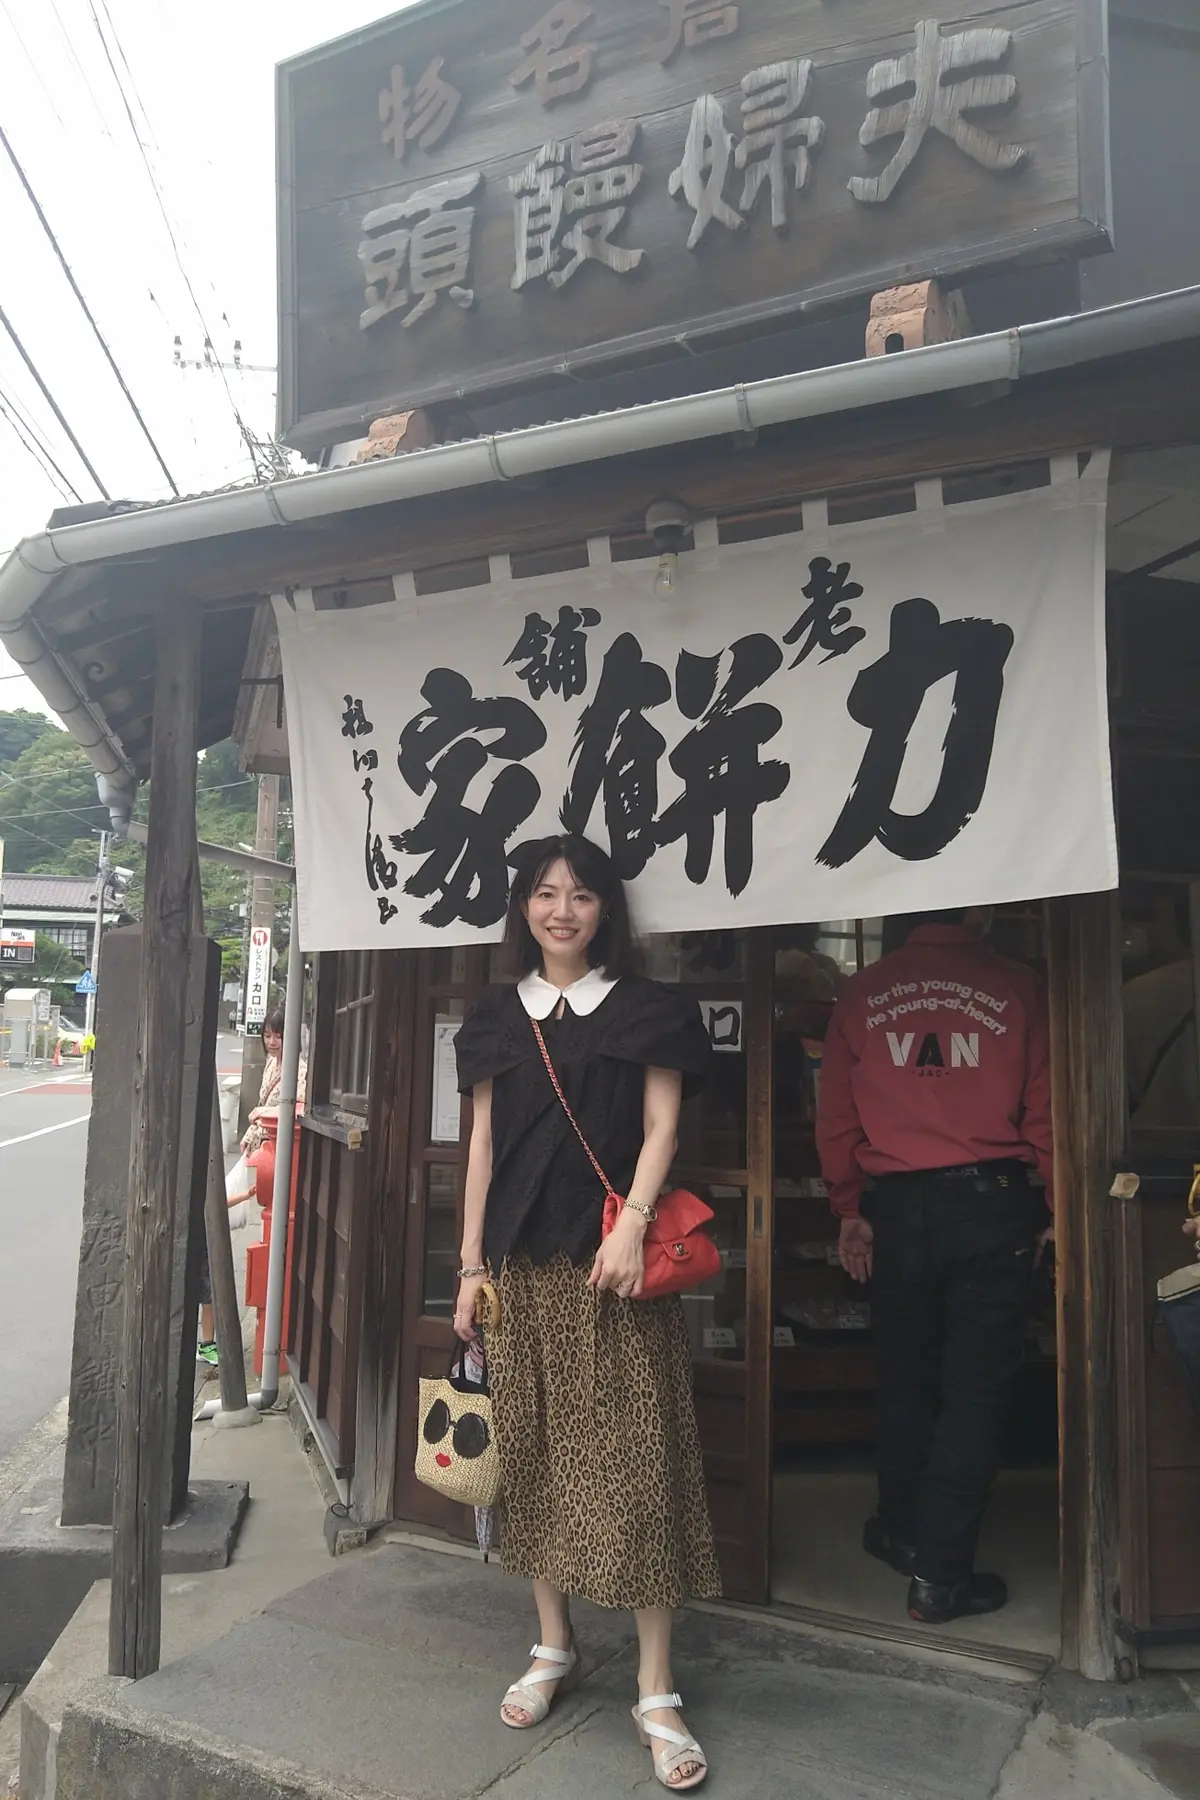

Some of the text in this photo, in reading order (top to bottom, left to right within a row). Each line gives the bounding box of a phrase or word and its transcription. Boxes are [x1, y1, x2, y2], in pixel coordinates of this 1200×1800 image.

[2, 948, 16, 957] IN
[867, 980, 1008, 1013] for the young and
[887, 998, 1007, 1036] young-at-heart
[886, 1032, 979, 1068] VAN
